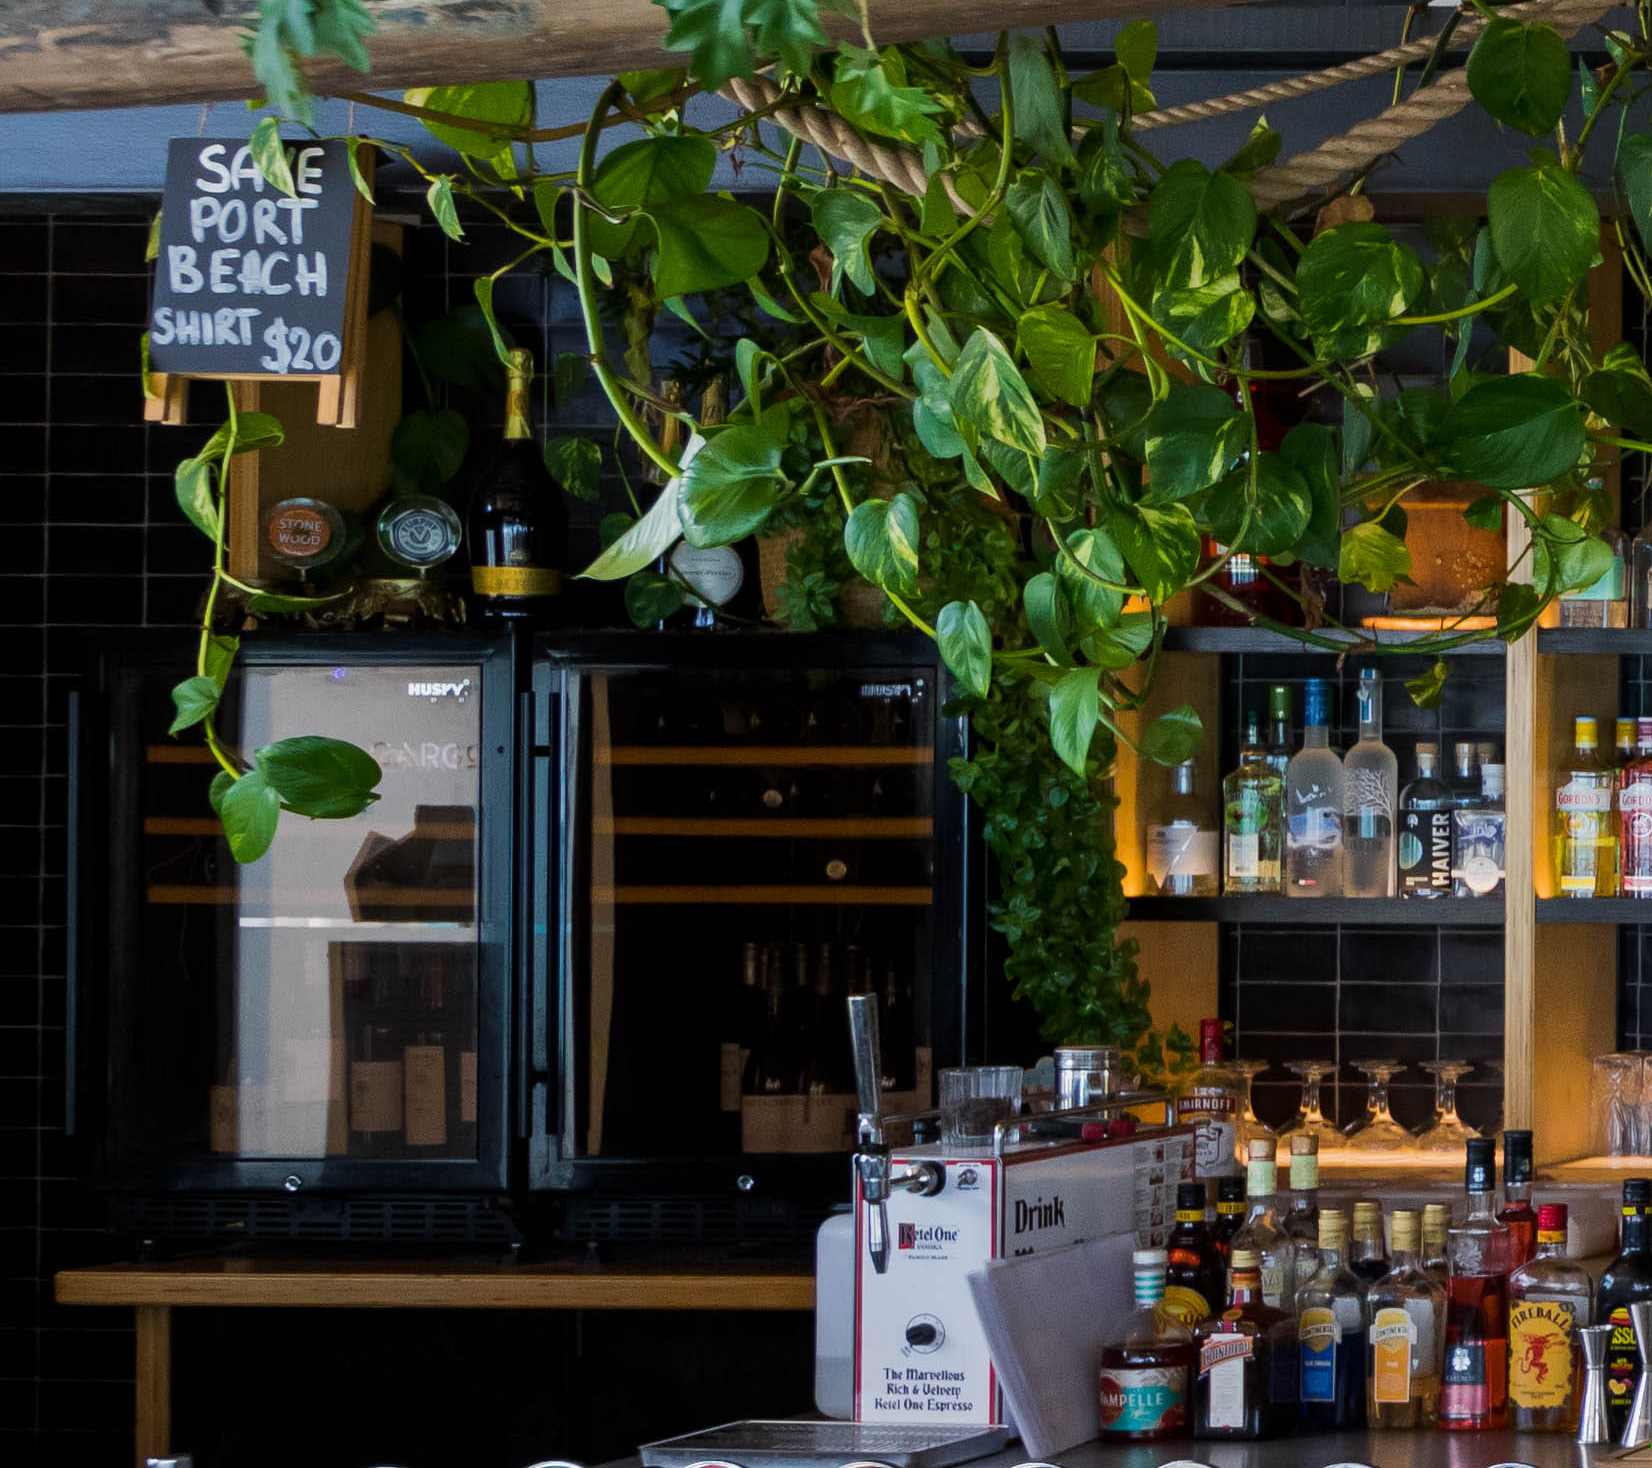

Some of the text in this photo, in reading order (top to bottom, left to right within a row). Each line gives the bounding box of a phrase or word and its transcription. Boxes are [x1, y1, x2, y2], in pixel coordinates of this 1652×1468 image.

[190, 198, 319, 245] PORT
[168, 245, 328, 297] BEACH
[153, 308, 341, 374] SHIRT $20
[279, 519, 321, 532] STONE
[279, 533, 321, 545] WOOD
[1014, 1195, 1066, 1235] Drink
[899, 1225, 959, 1246] Ketel One
[1511, 1306, 1569, 1332] FIREBALL
[883, 1367, 965, 1381] The Marvellous
[887, 1383, 962, 1400] Rich & Velvety
[874, 1398, 974, 1412] Ketel One Espresso
